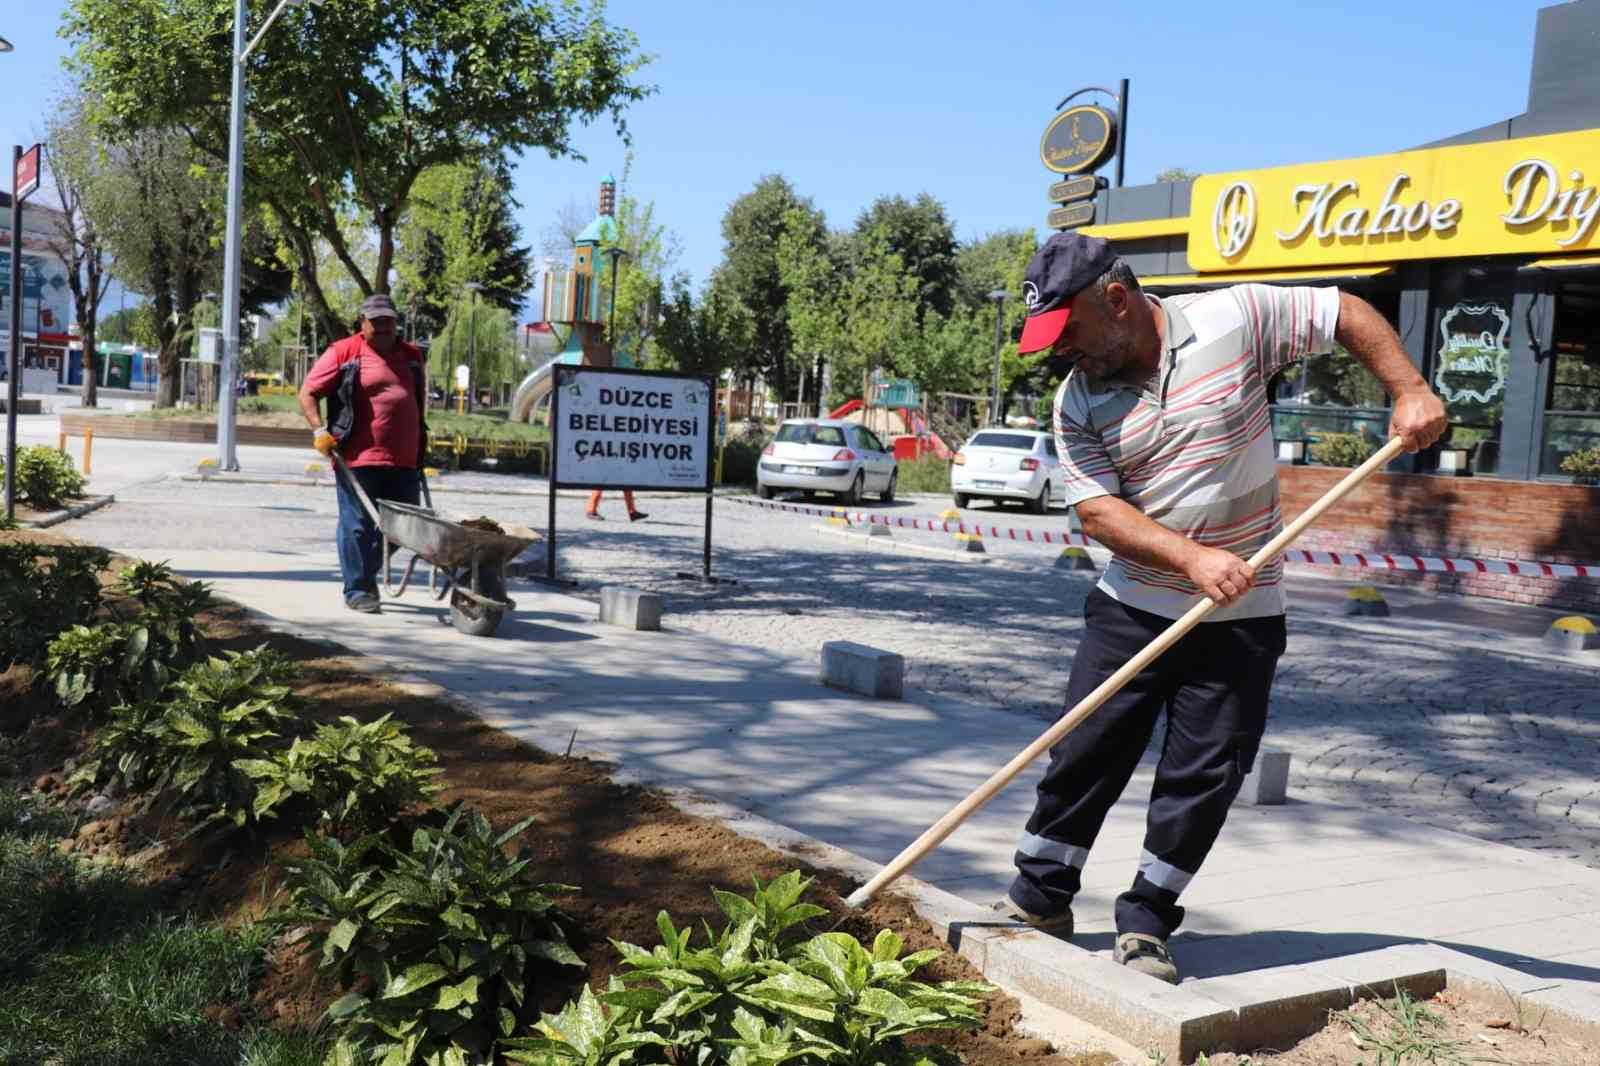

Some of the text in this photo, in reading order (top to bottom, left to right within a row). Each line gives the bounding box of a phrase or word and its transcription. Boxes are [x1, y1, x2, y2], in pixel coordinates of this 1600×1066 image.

[1277, 173, 1461, 242] Kahve
[599, 386, 673, 409] DÜZCE
[569, 413, 698, 437] BELEDİYESİ
[574, 440, 693, 463] ÇALIŞIYOR
